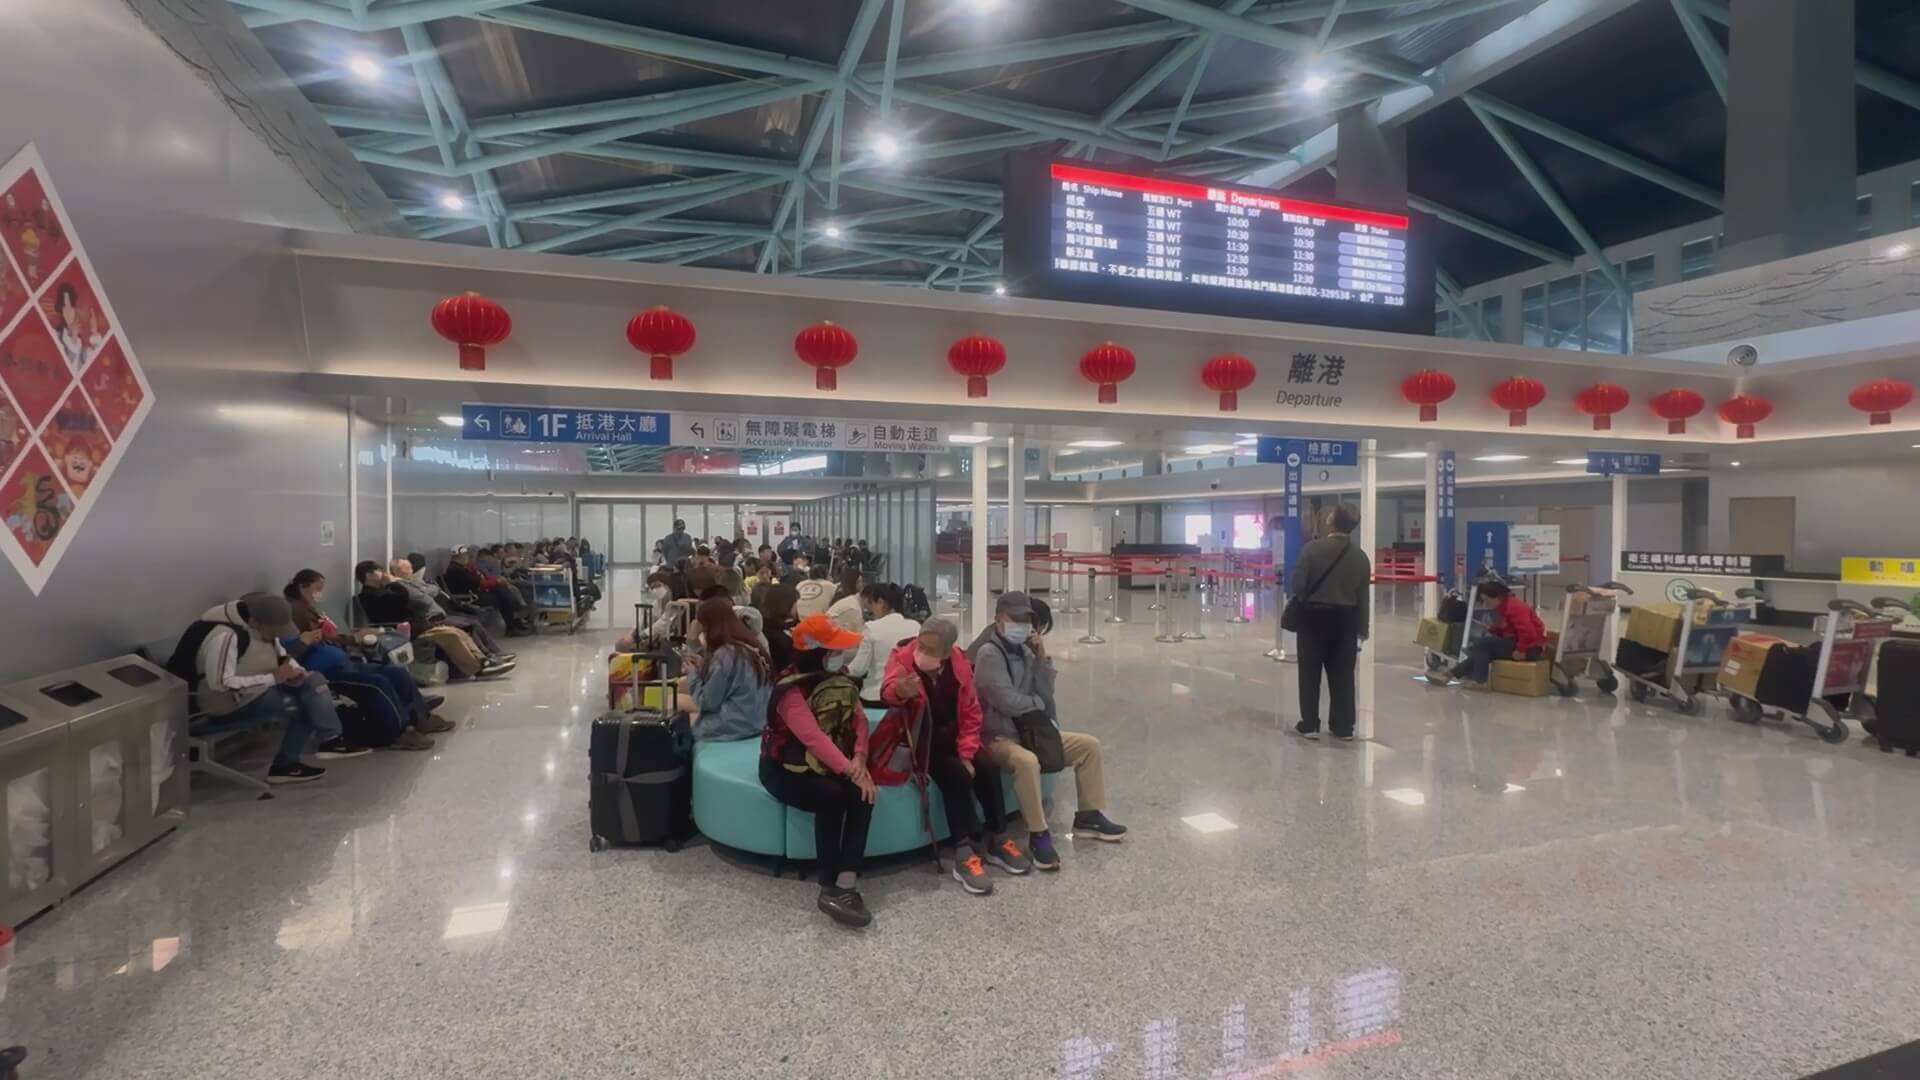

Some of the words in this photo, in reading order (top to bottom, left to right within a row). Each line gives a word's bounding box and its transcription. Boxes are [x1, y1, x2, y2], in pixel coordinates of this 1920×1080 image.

[1177, 198, 1192, 208] Port
[1166, 209, 1182, 219] WT
[1166, 221, 1182, 232] WT
[1166, 234, 1182, 244] WT
[1166, 246, 1182, 256] WT
[1166, 259, 1182, 269] WT
[1287, 352, 1345, 385] 離港
[1276, 390, 1342, 408] Departure
[537, 413, 568, 437] 1F
[576, 412, 657, 433] 抵港大廳
[745, 419, 836, 438] 無障礙電梯
[576, 431, 610, 441] Arrival
[612, 431, 632, 442] Hall
[873, 425, 938, 443] 自動走道
[745, 437, 793, 447] Accessible
[796, 438, 833, 448] Elevator
[874, 441, 905, 450] Moving
